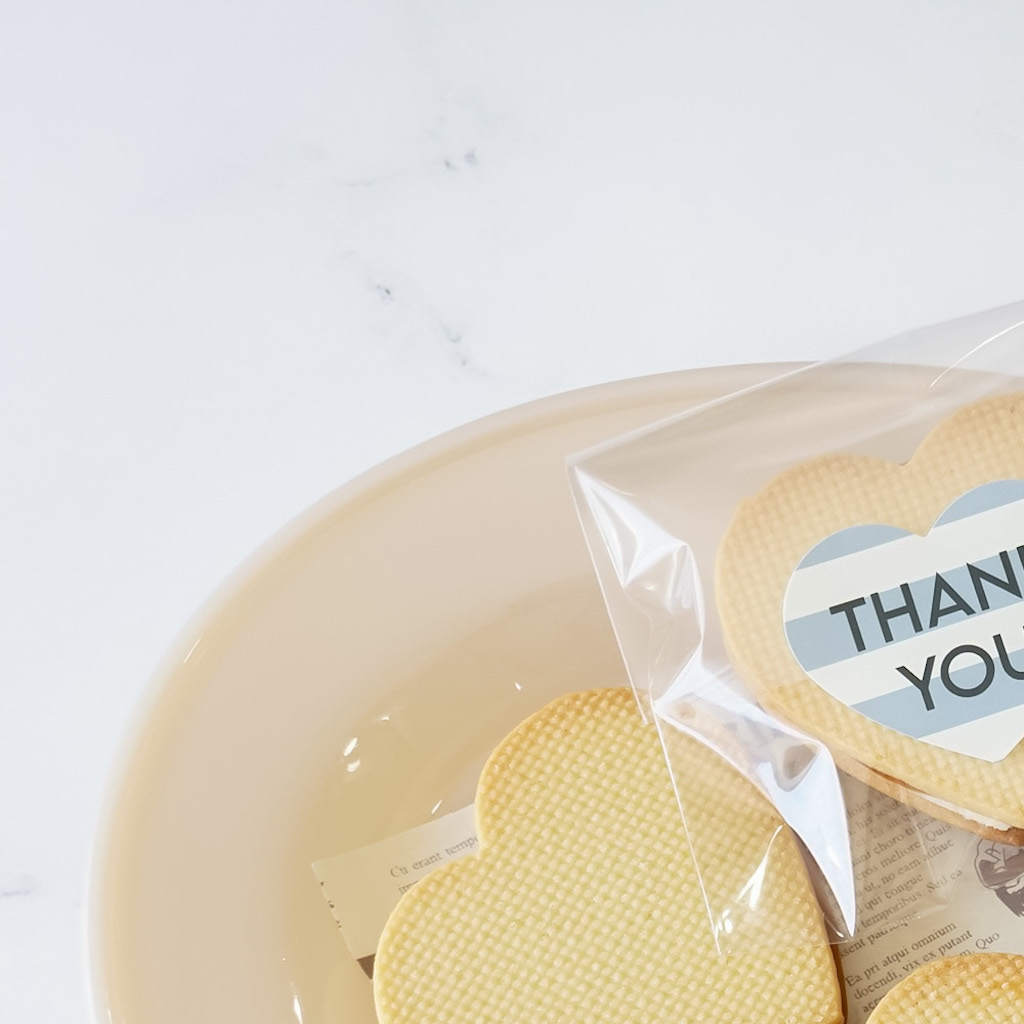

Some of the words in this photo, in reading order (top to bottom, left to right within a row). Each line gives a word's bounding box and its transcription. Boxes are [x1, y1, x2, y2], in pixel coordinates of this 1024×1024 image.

[863, 964, 880, 980] pri
[910, 922, 957, 951] omnium
[937, 929, 973, 957] putant
[975, 932, 1001, 950] Quo
